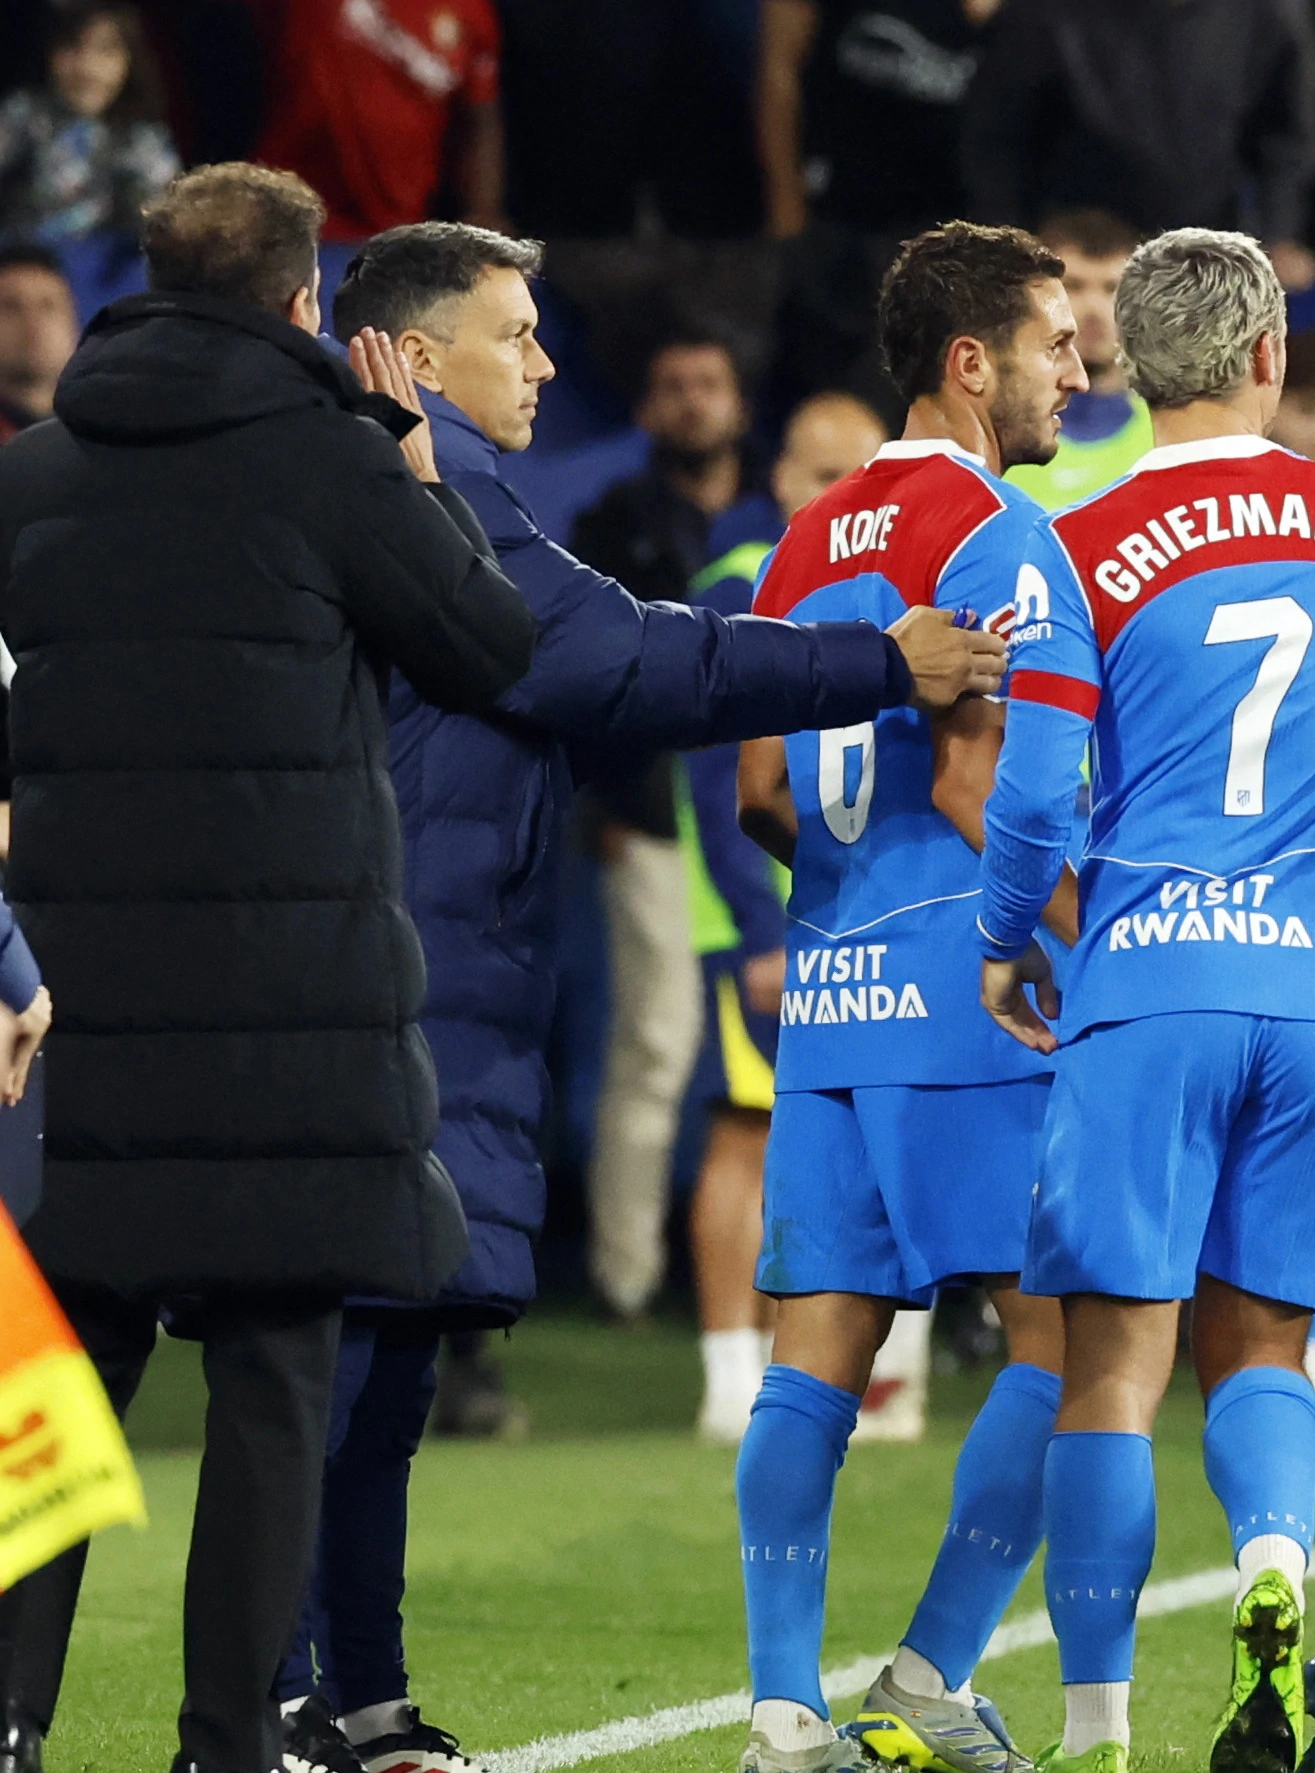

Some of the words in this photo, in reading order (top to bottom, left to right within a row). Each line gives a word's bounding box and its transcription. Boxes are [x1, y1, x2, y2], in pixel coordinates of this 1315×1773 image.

[1203, 596, 1314, 817] 7
[1160, 873, 1275, 911] VISIT
[1108, 908, 1314, 951] RWANDA
[797, 944, 888, 984] VISIT
